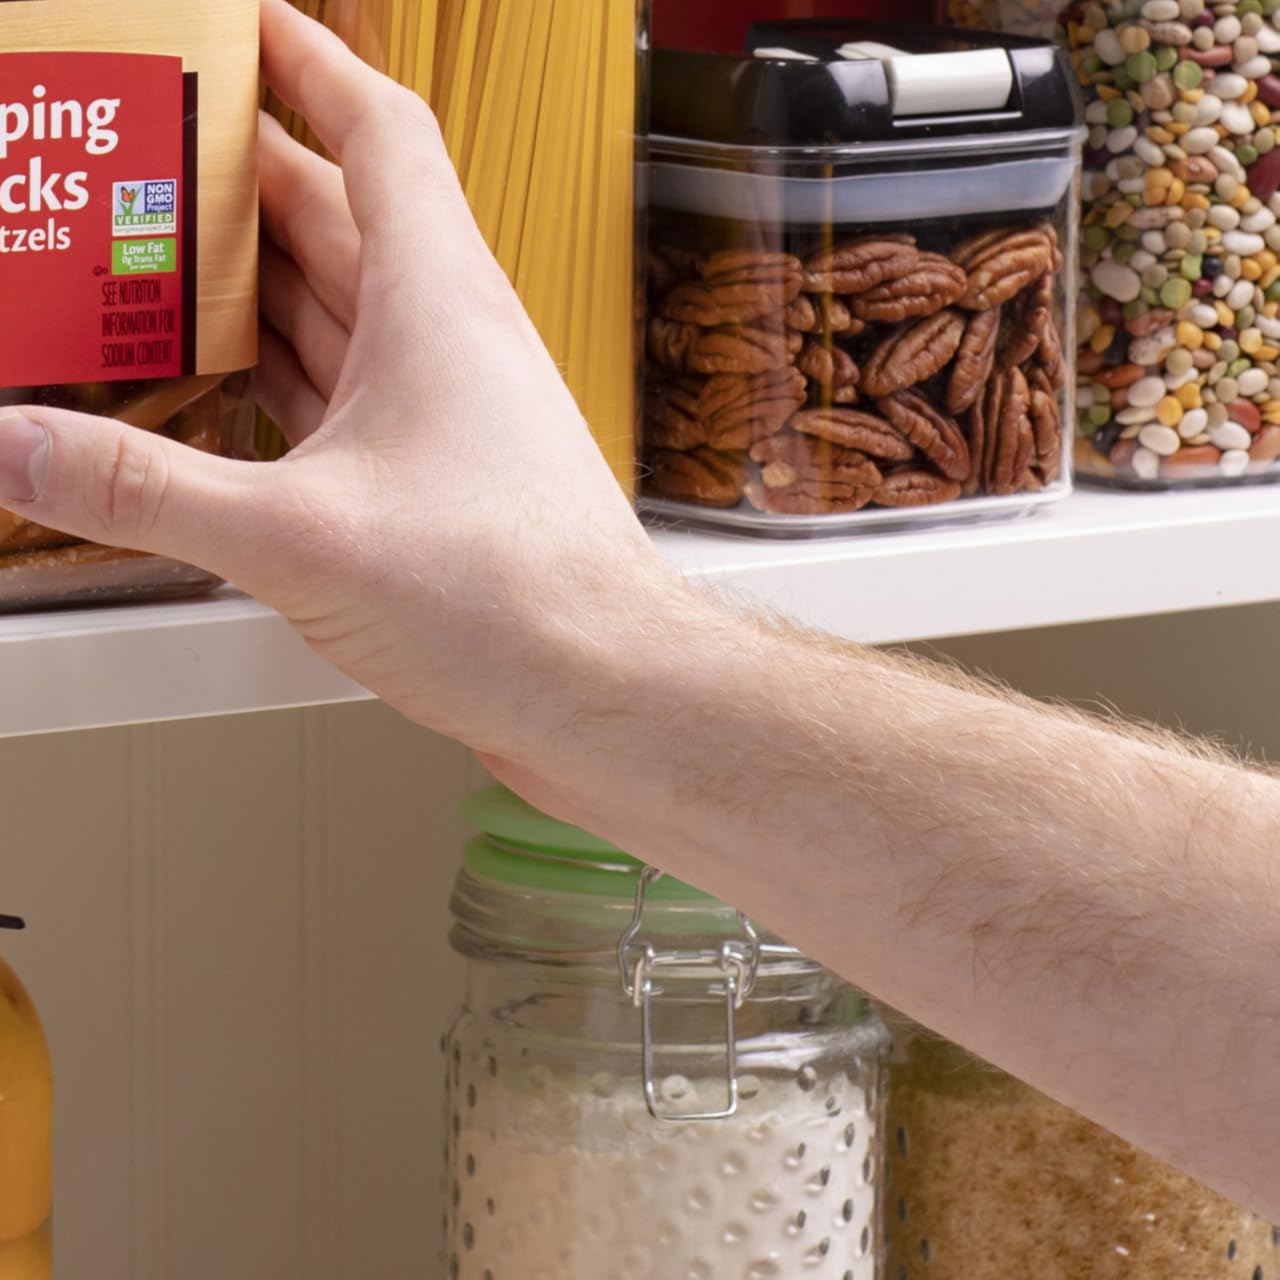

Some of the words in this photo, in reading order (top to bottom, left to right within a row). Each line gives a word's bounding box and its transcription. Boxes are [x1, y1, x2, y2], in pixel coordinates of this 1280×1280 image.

[147, 184, 172, 194] NON
[146, 194, 173, 204] GMO
[146, 204, 172, 212] Project
[116, 214, 172, 225] VERIFIED
[123, 243, 145, 255] Low
[147, 242, 165, 254] Fat
[134, 255, 153, 263] Trans
[154, 254, 166, 262] Fat
[102, 281, 117, 306] SEE
[120, 279, 161, 304] NUTRITION
[102, 310, 157, 336] INFORMATION
[160, 309, 175, 333] FOR
[102, 342, 135, 368] SODIUM
[137, 339, 173, 365] CONTENT
